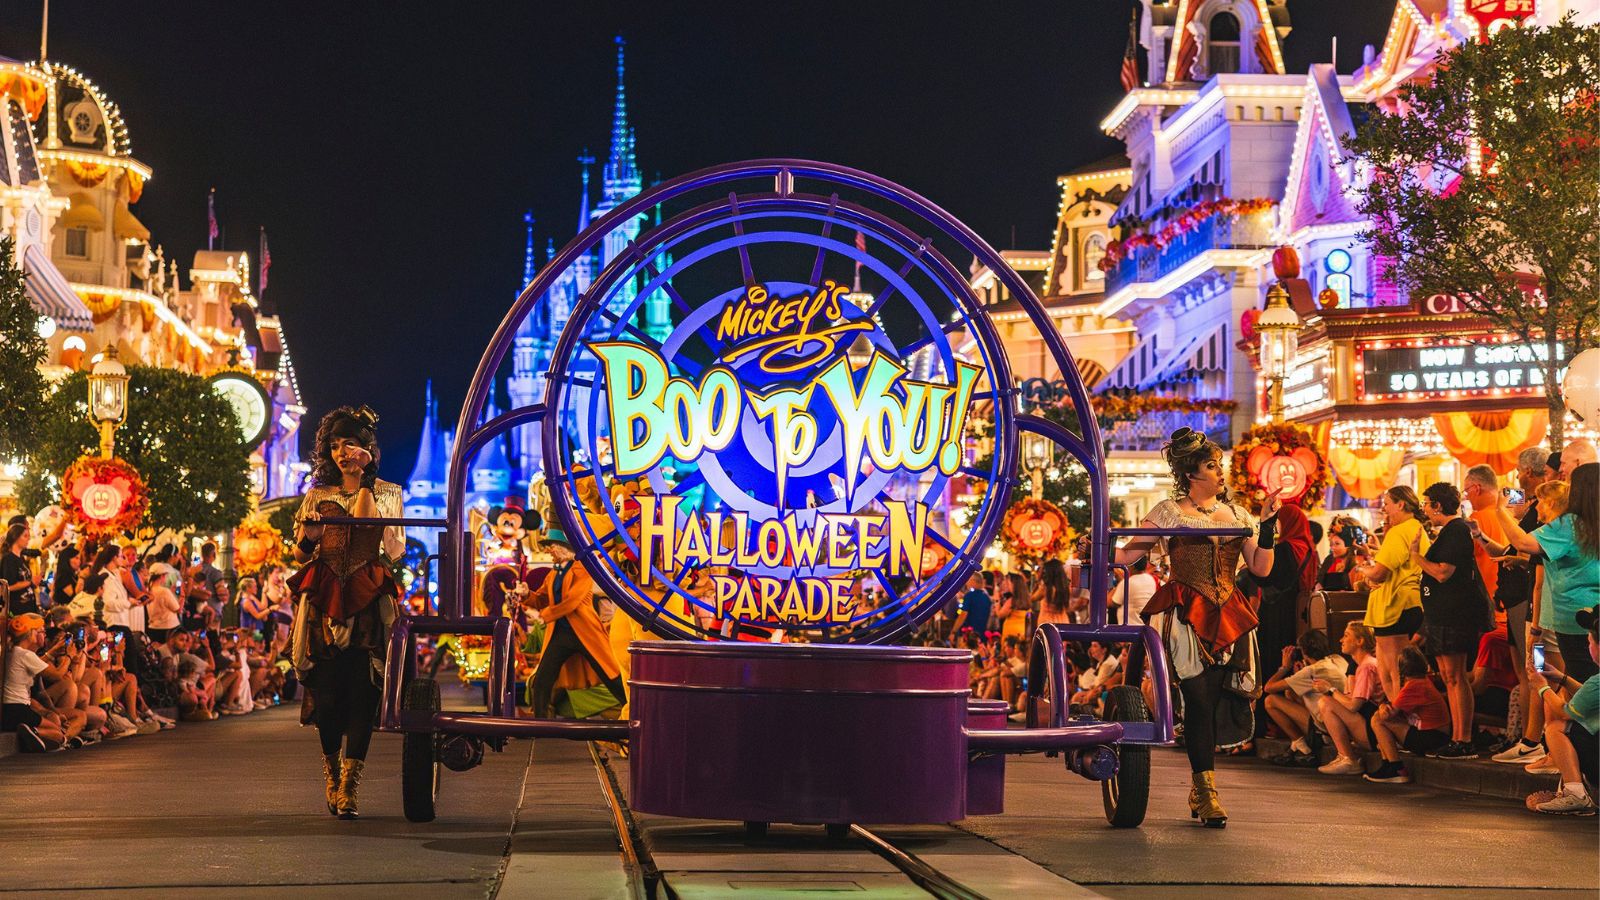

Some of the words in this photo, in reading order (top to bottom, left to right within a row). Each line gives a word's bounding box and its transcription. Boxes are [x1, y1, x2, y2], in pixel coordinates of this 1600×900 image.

[1420, 348, 1465, 367] NOW
[1390, 373, 1418, 391] 50
[1422, 370, 1490, 389] YEARS
[1494, 368, 1523, 386] OF
[630, 494, 928, 589] HALLOWEEN
[712, 571, 858, 623] PARADE
